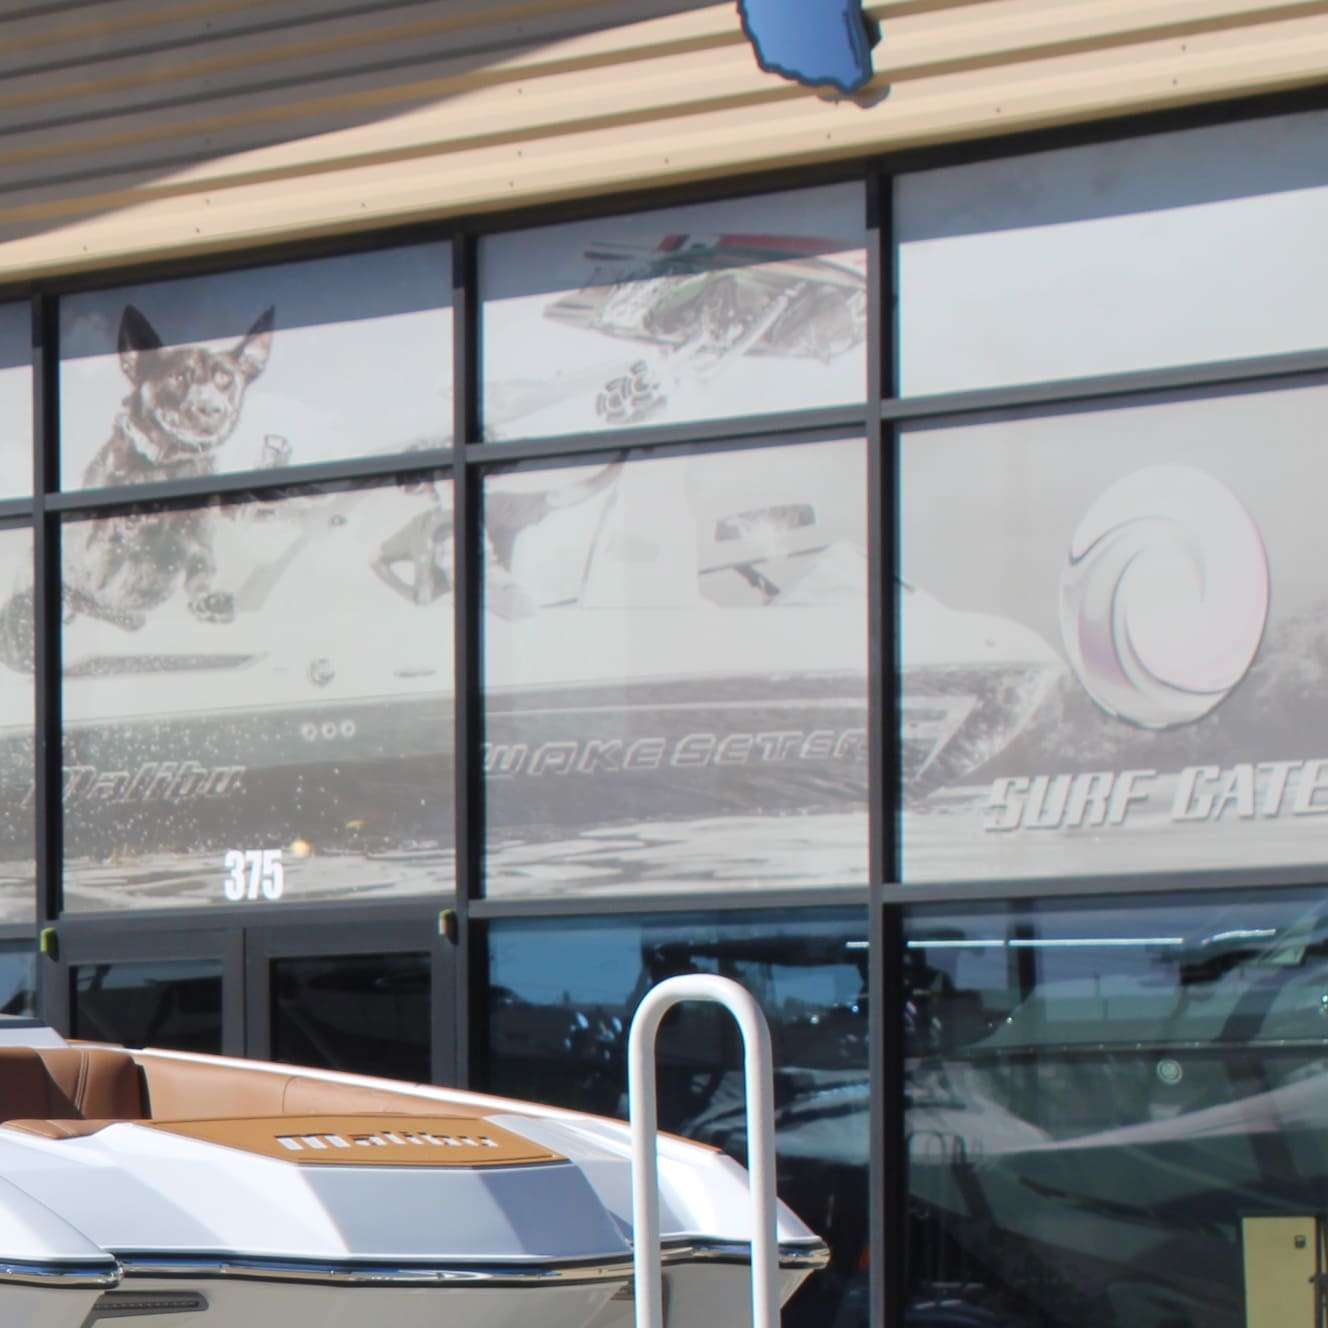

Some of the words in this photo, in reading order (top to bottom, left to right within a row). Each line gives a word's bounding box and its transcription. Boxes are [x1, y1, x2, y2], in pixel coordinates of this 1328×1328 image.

[984, 768, 1158, 834] SURF
[1172, 758, 1328, 823] GATE
[224, 849, 284, 900] 375
